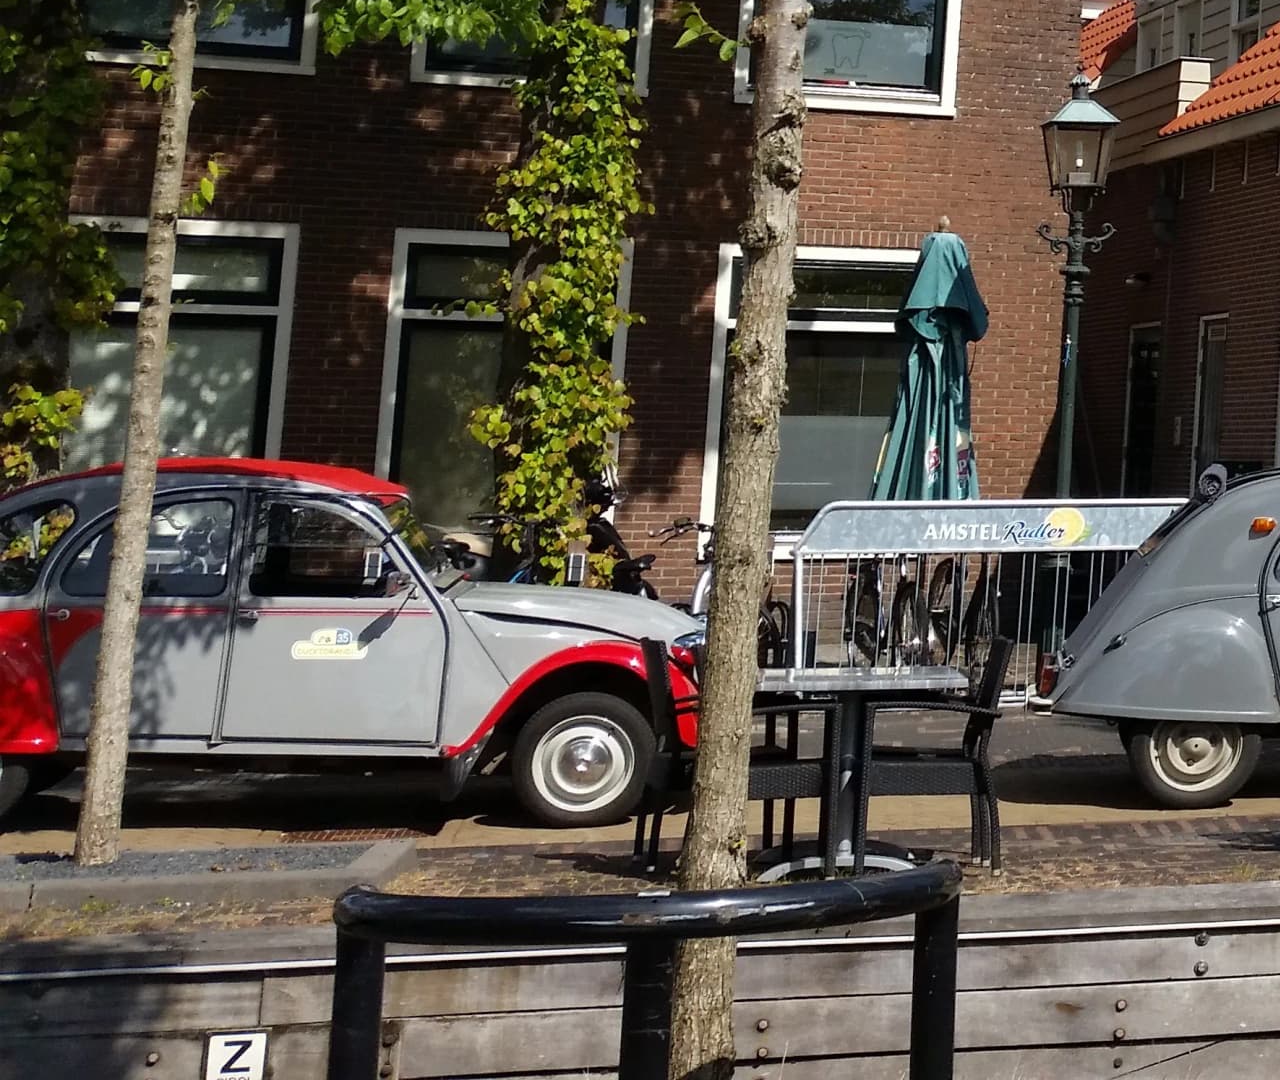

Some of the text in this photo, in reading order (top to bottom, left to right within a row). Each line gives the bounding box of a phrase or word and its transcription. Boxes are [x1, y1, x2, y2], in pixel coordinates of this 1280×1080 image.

[924, 521, 1065, 545] AMSTEL Radler
[220, 1040, 253, 1074] Z
